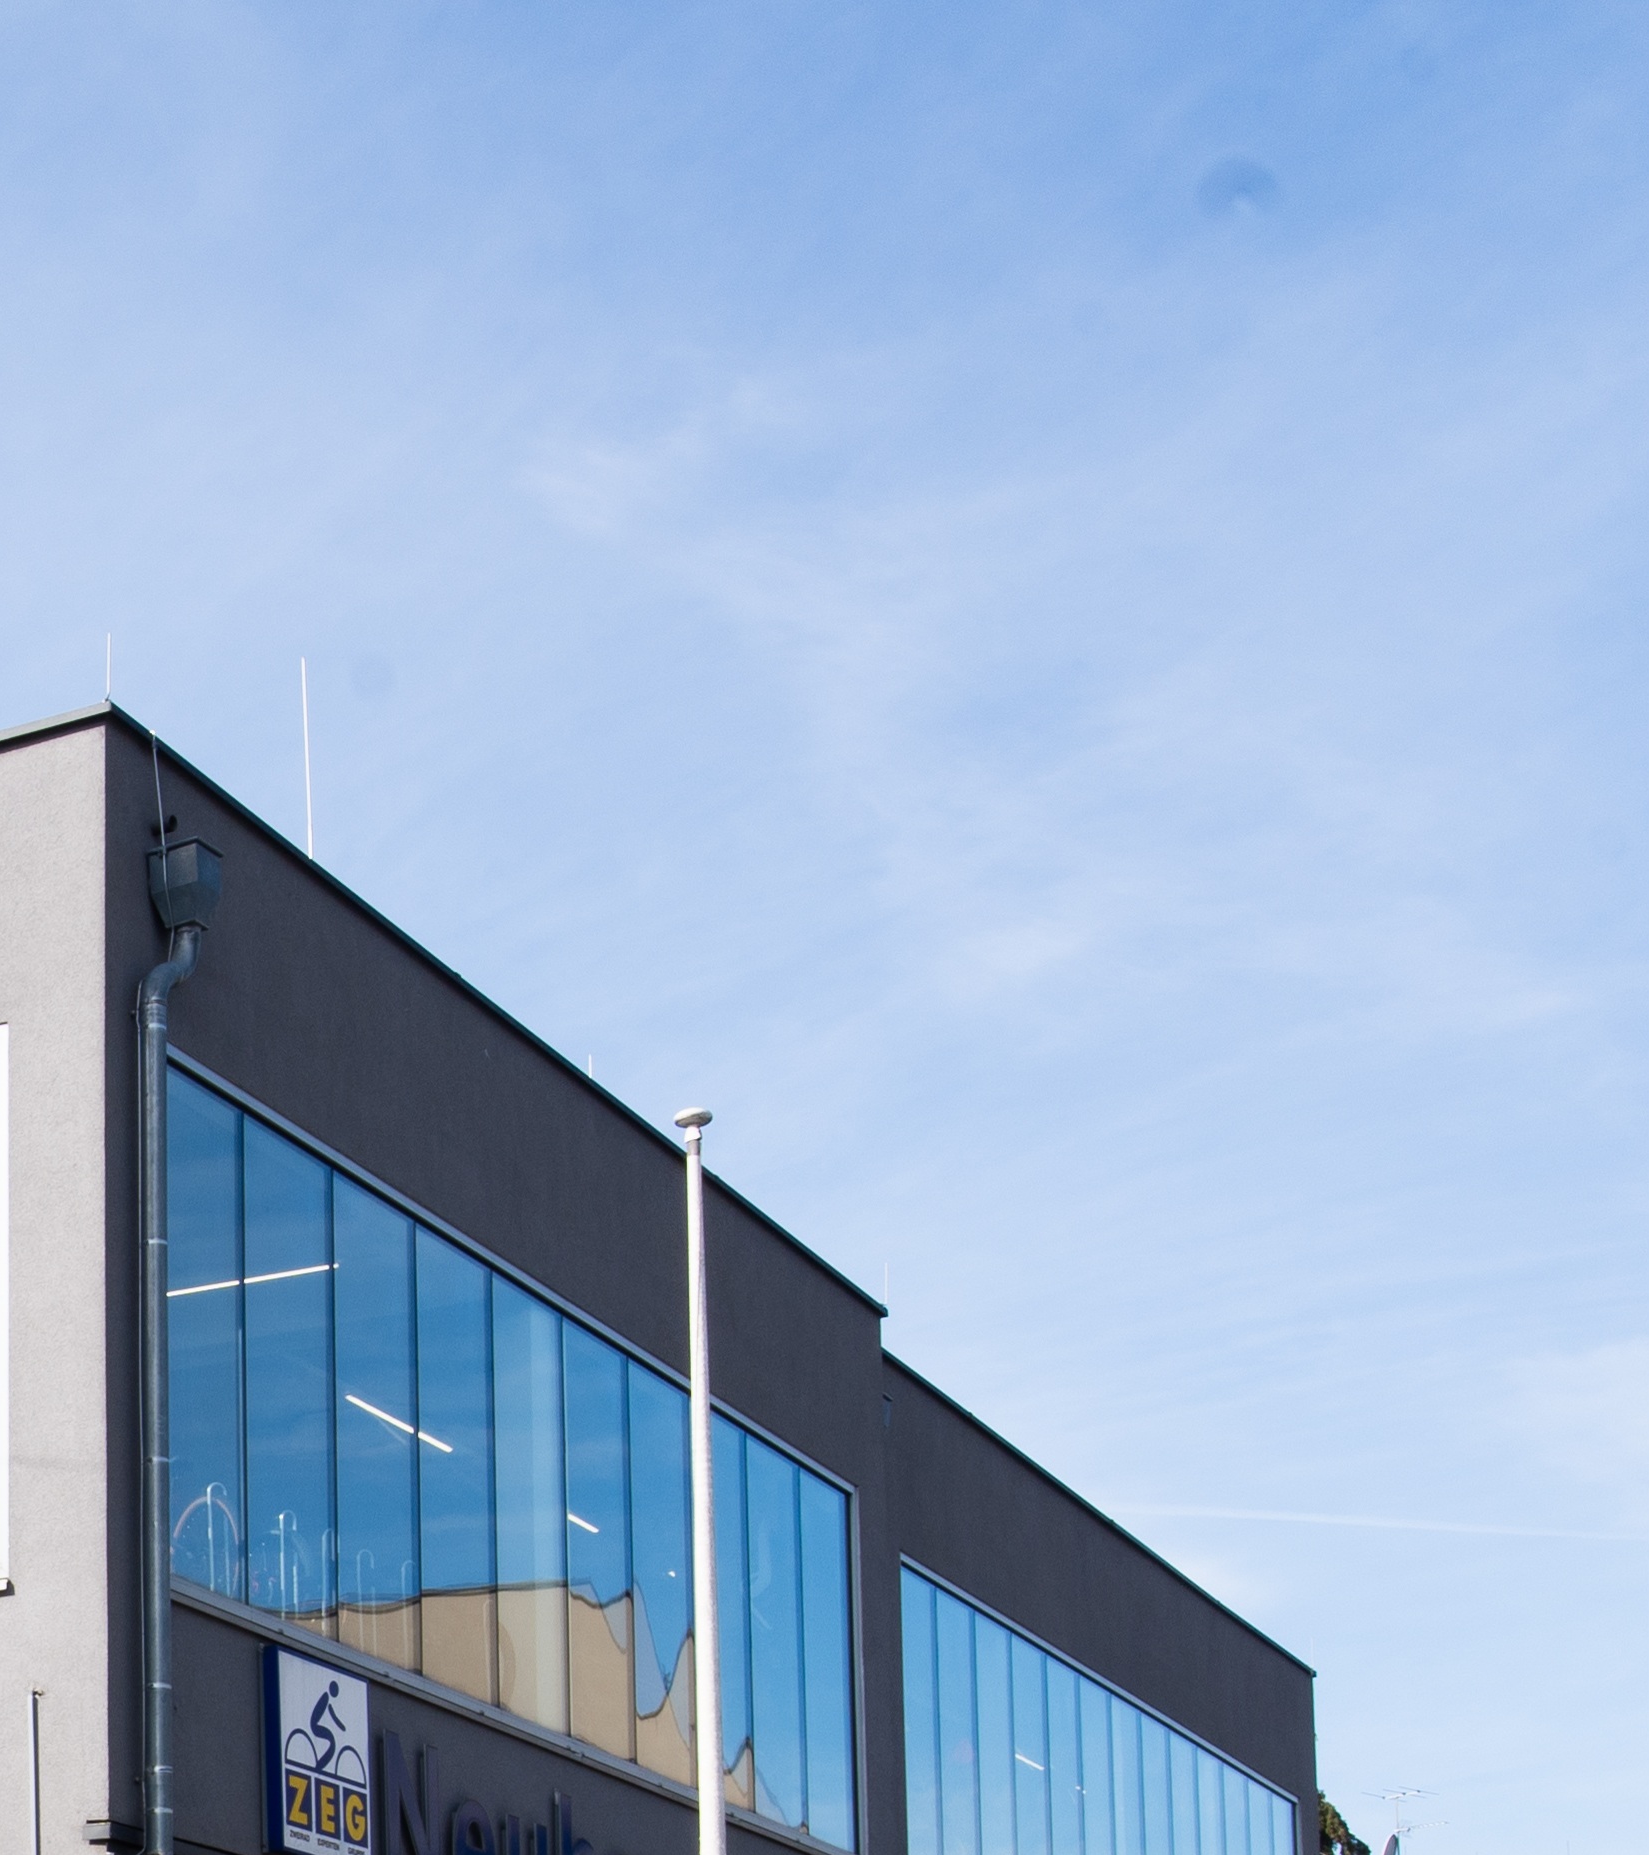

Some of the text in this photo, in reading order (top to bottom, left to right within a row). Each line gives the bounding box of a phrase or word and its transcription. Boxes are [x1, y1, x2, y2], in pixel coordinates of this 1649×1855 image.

[289, 1775, 366, 1842] ZEG
[290, 1830, 310, 1842] ZWEIRAD
[317, 1838, 340, 1851] EXPERTEN
